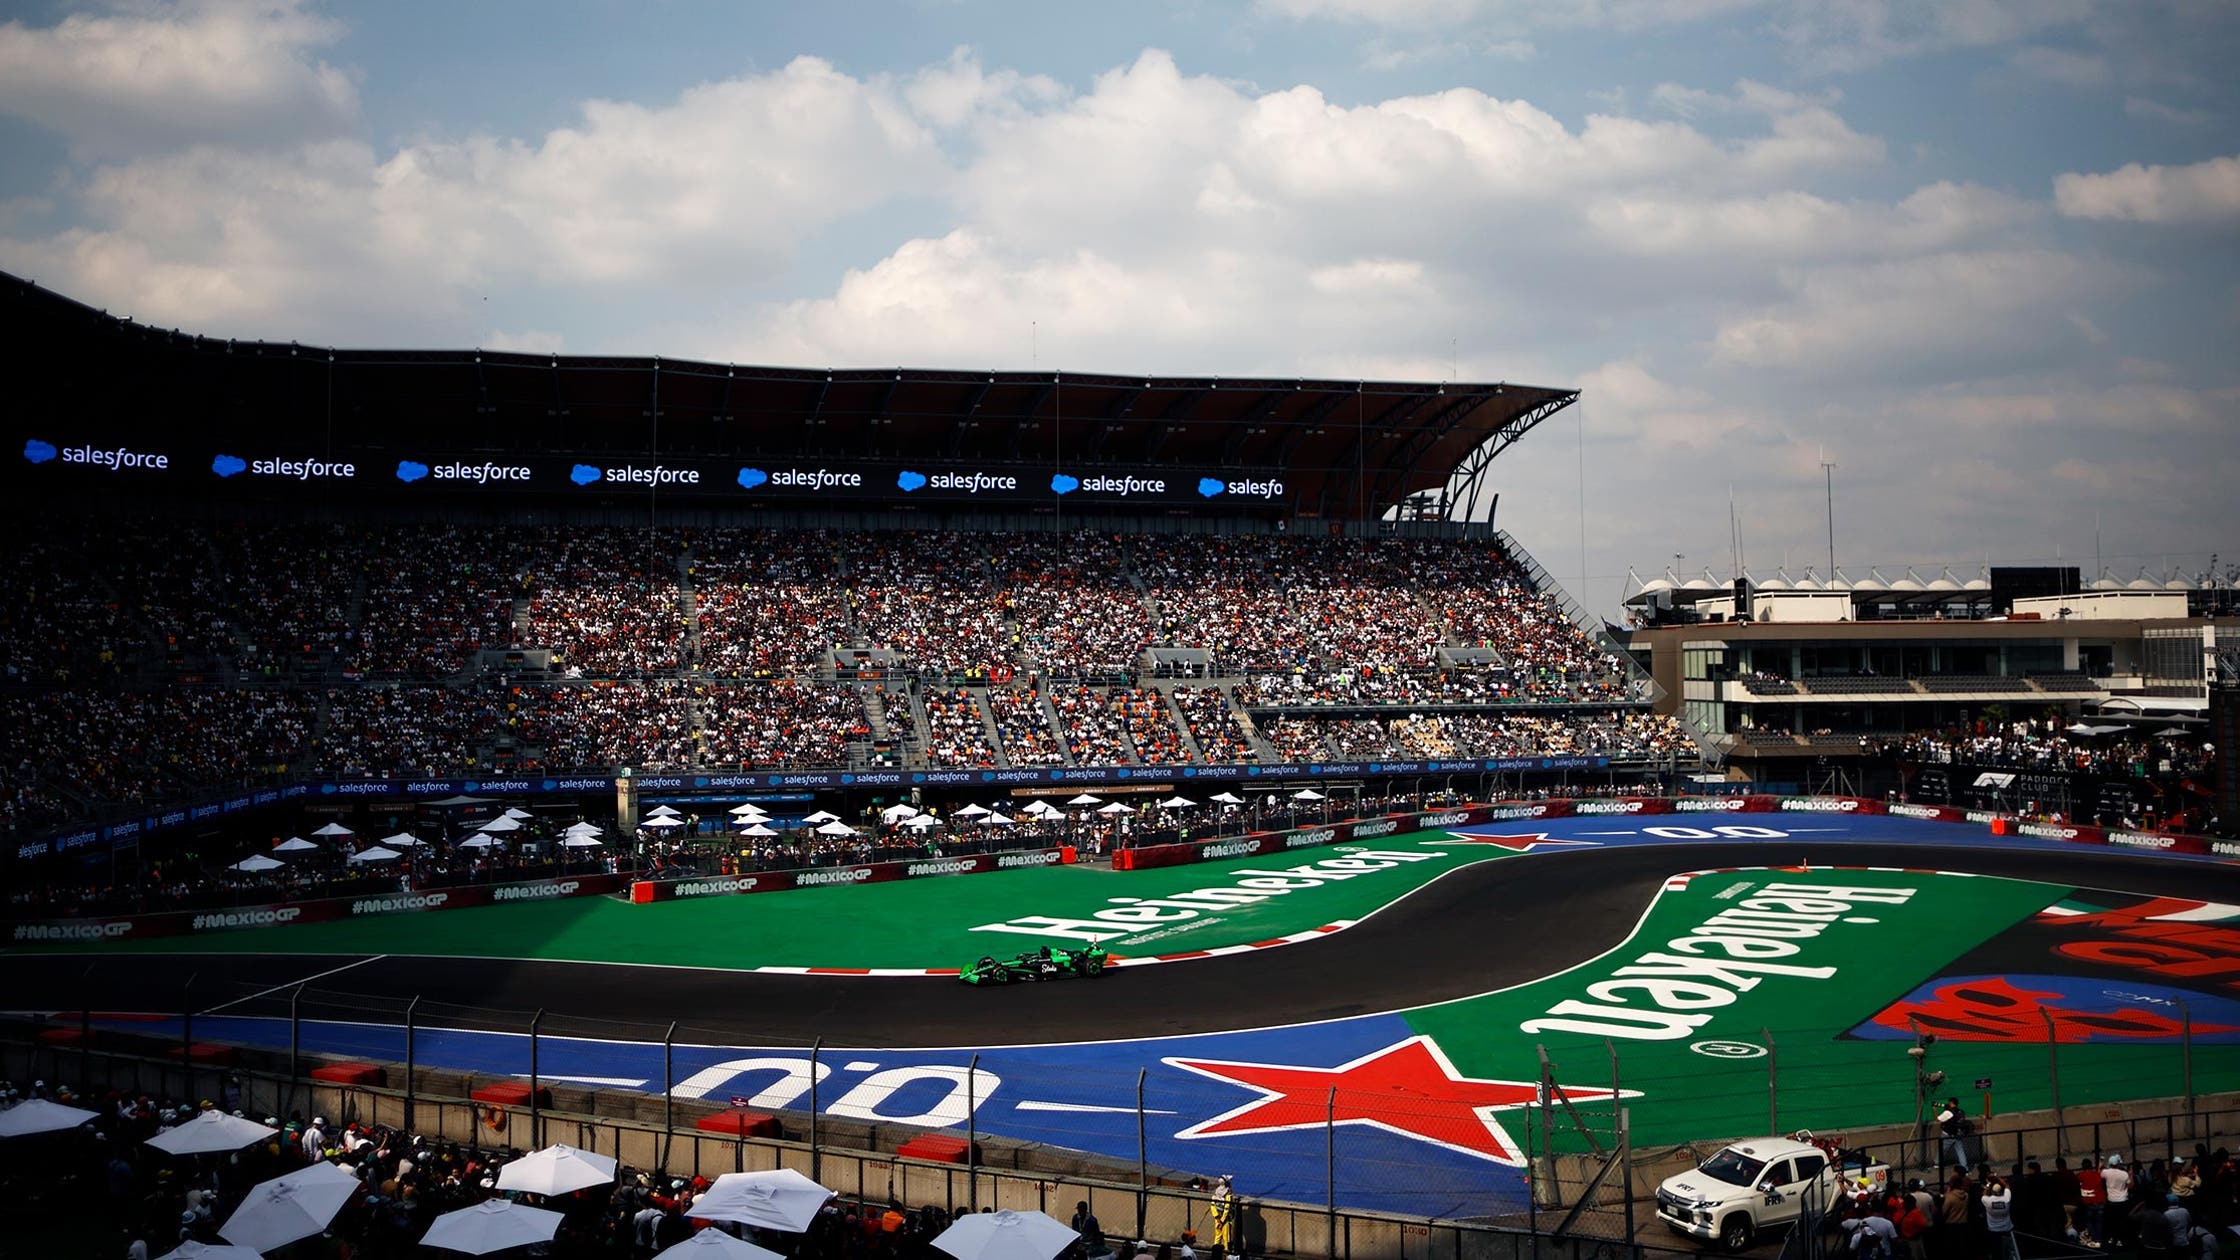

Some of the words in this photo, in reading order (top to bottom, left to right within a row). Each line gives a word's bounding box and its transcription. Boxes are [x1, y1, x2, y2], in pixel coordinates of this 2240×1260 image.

[62, 445, 168, 470] salesforce
[251, 457, 355, 480] salesforce
[433, 462, 531, 484] salesforce
[606, 465, 700, 487] salesforce
[771, 469, 862, 491] salesforce
[930, 472, 1017, 494] salesforce
[1082, 475, 1166, 496] salesforce
[1228, 478, 1283, 500] salesfo
[1261, 764, 1299, 777] salesforce
[1322, 763, 1360, 775] salesforce
[1382, 761, 1418, 773] salesforce
[1440, 760, 1476, 772] salesforce
[1497, 759, 1533, 770] salesforce
[1553, 757, 1589, 769] salesforce
[856, 772, 900, 785] salesforce
[927, 771, 970, 783] salesforce
[997, 769, 1039, 782] salesforce
[1065, 768, 1106, 781] salesforce
[1131, 767, 1172, 779] salesforce
[1197, 766, 1237, 778] salesforce
[481, 780, 529, 792] salesforce
[560, 779, 606, 790] salesforce
[710, 775, 756, 787] salesforce
[784, 774, 828, 786] salesforce
[339, 783, 388, 794] salesforce
[1576, 802, 1643, 815] #MexicoGP
[1676, 800, 1745, 810] #MexicoGP
[1782, 800, 1859, 811] #MexicoGP
[1889, 804, 1940, 818] #MexicoGP
[1493, 806, 1547, 820] #MexicoGP
[1419, 813, 1469, 829] #MexicoGP
[1353, 821, 1397, 838] #MexicoGP
[2018, 824, 2078, 839] #MexicoGP
[1286, 830, 1335, 847] #MexicoGP
[2109, 832, 2175, 848] #MexicoGP
[1203, 841, 1261, 859] #MexicoGP
[998, 851, 1061, 869] #MexicoGP
[908, 860, 977, 876] #MexicoGP
[797, 869, 872, 886] #MexicoGP
[494, 881, 579, 900] #MexicoGP
[675, 878, 757, 896] #MexicoGP
[968, 848, 1448, 942] Heineken
[352, 892, 448, 914] #MexicoGP
[193, 907, 300, 930] #MexicoGP
[14, 922, 133, 940] #MexicoGP
[1520, 883, 1918, 1041] Heineken
